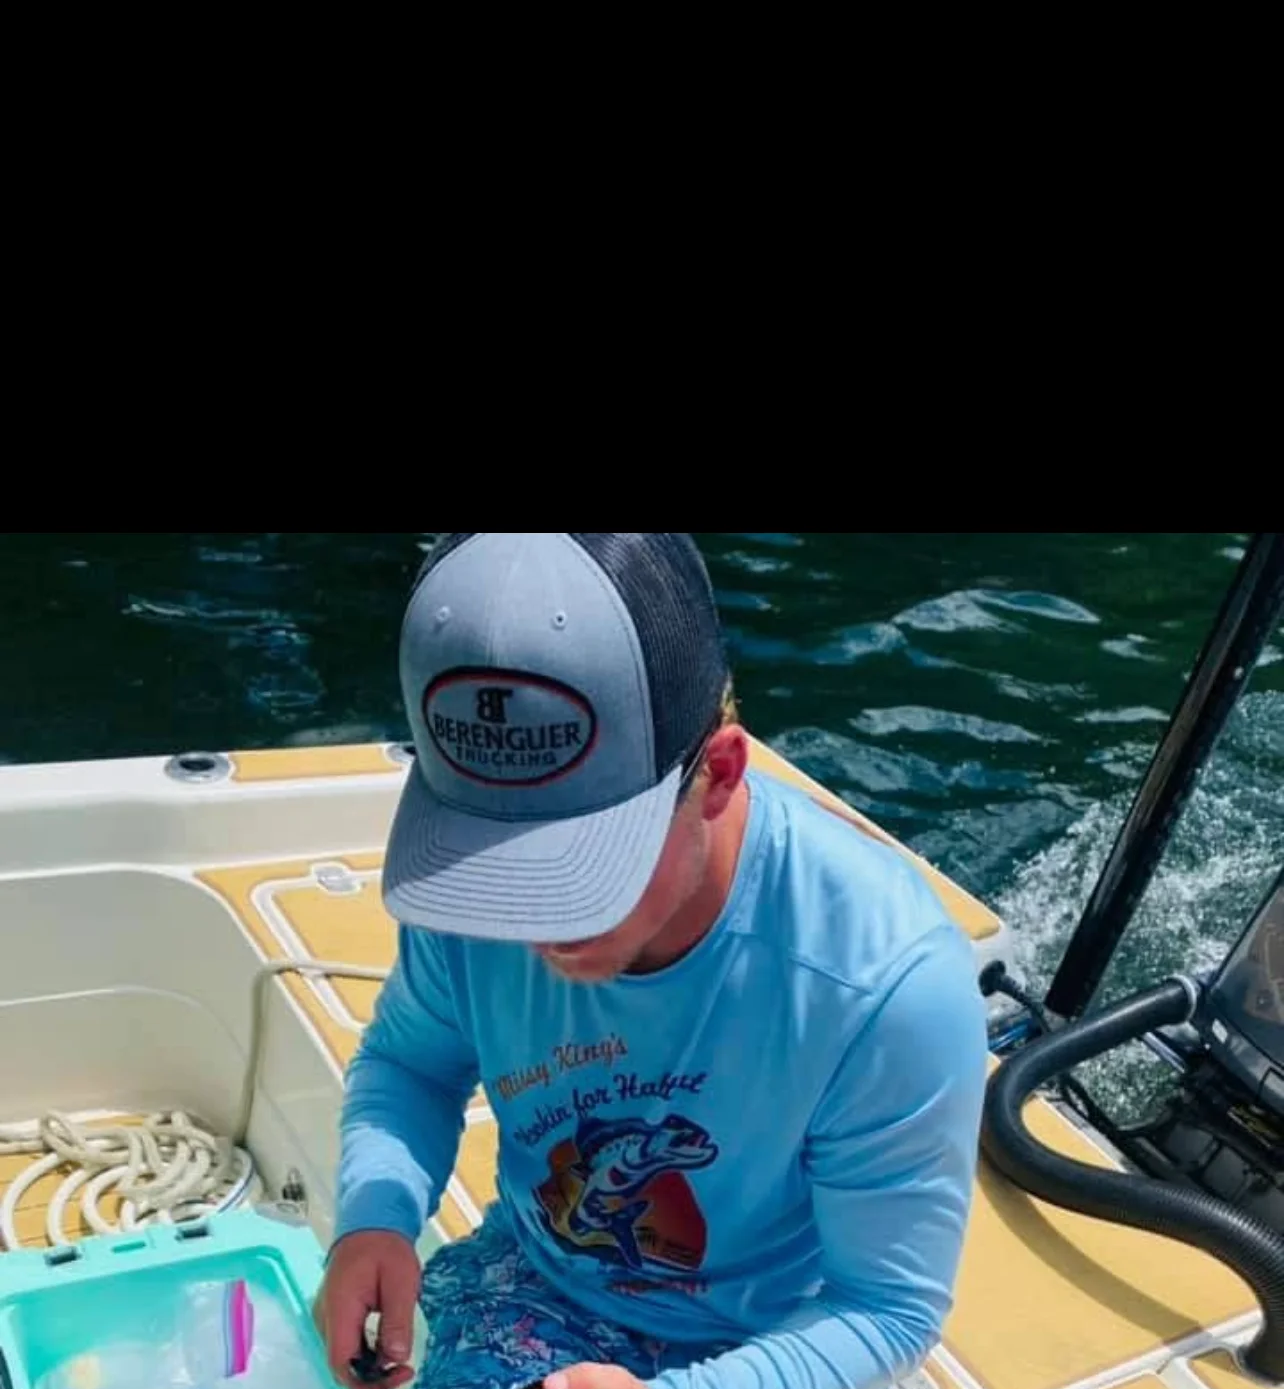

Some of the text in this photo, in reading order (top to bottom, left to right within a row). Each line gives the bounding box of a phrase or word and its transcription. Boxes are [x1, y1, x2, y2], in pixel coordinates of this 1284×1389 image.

[434, 714, 581, 750] BERENGUER
[457, 748, 556, 767] TRUCKING
[572, 1087, 612, 1120] for
